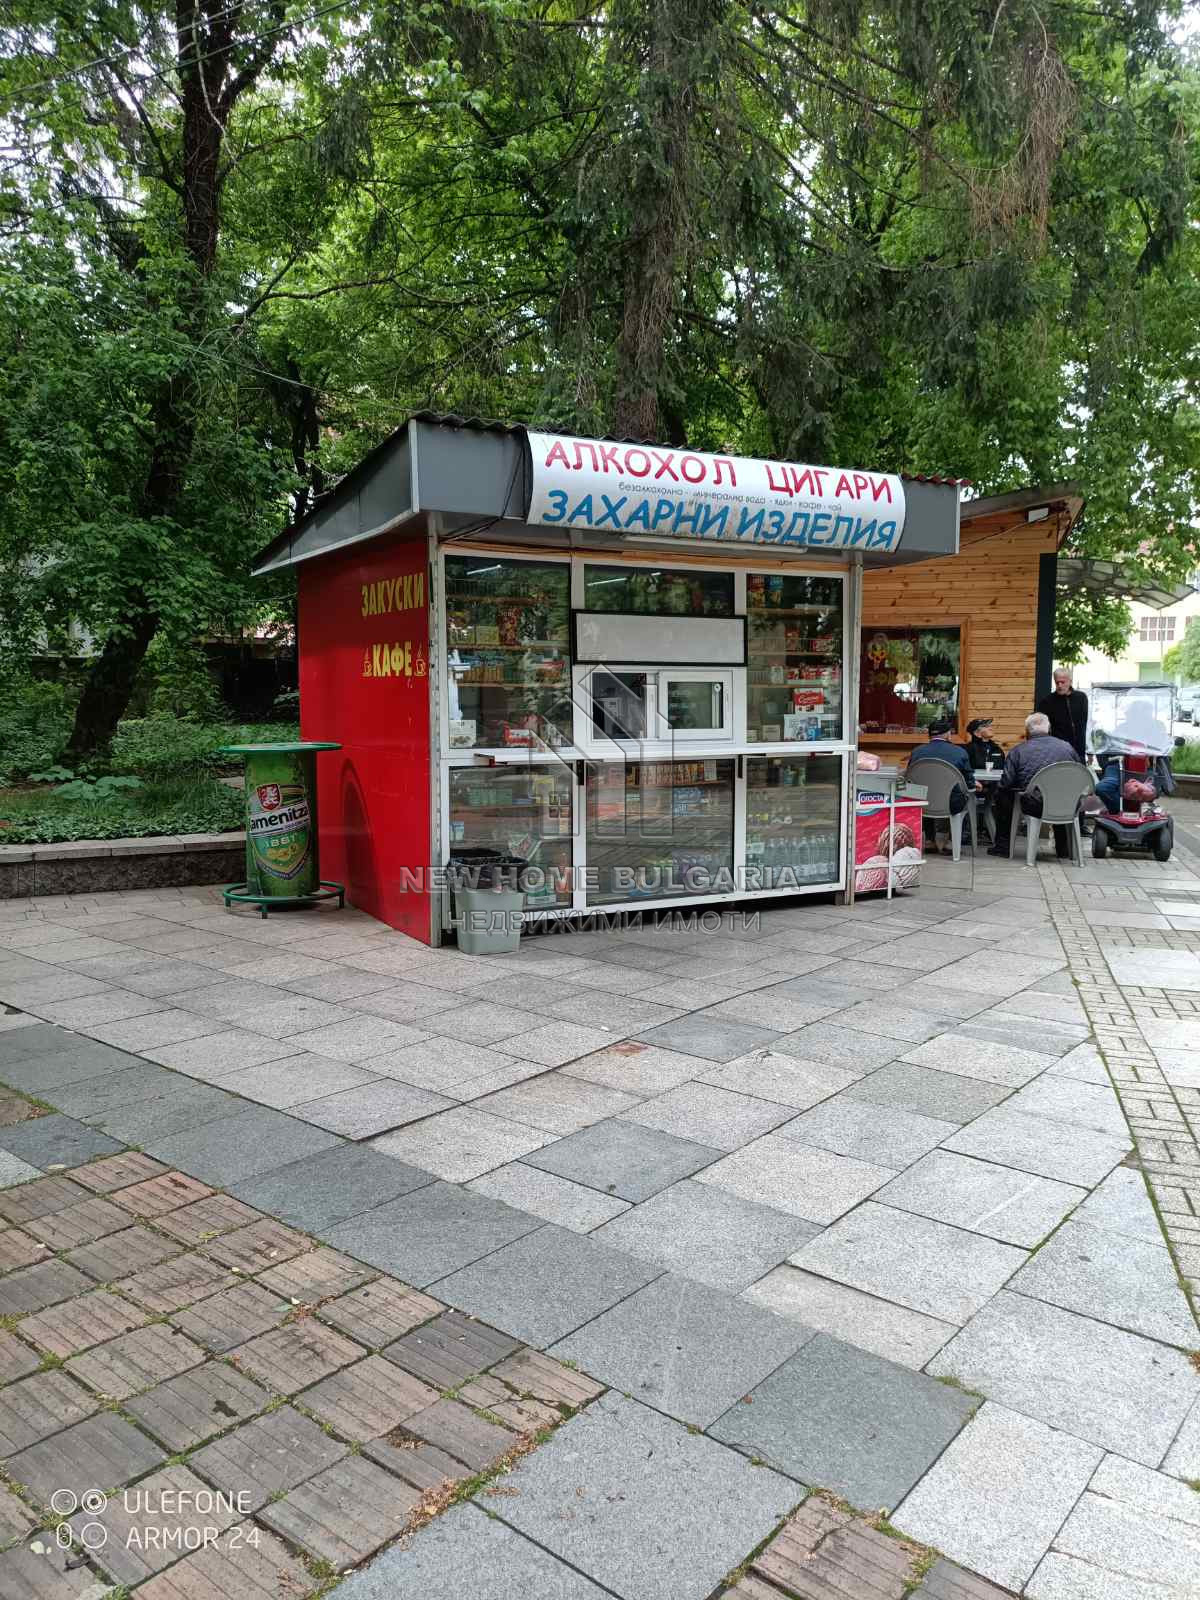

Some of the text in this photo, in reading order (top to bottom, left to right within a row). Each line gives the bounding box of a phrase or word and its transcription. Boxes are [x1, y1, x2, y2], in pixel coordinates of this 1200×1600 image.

[545, 440, 892, 505] АЛКОХОЛ ЦИГАРИ
[542, 489, 897, 549] ЗАХАРНИ ИЗДЕЛИЯ
[361, 572, 424, 618] ЗАКУСКИ
[372, 641, 413, 677] КАФЕ
[249, 806, 308, 831] amenitza
